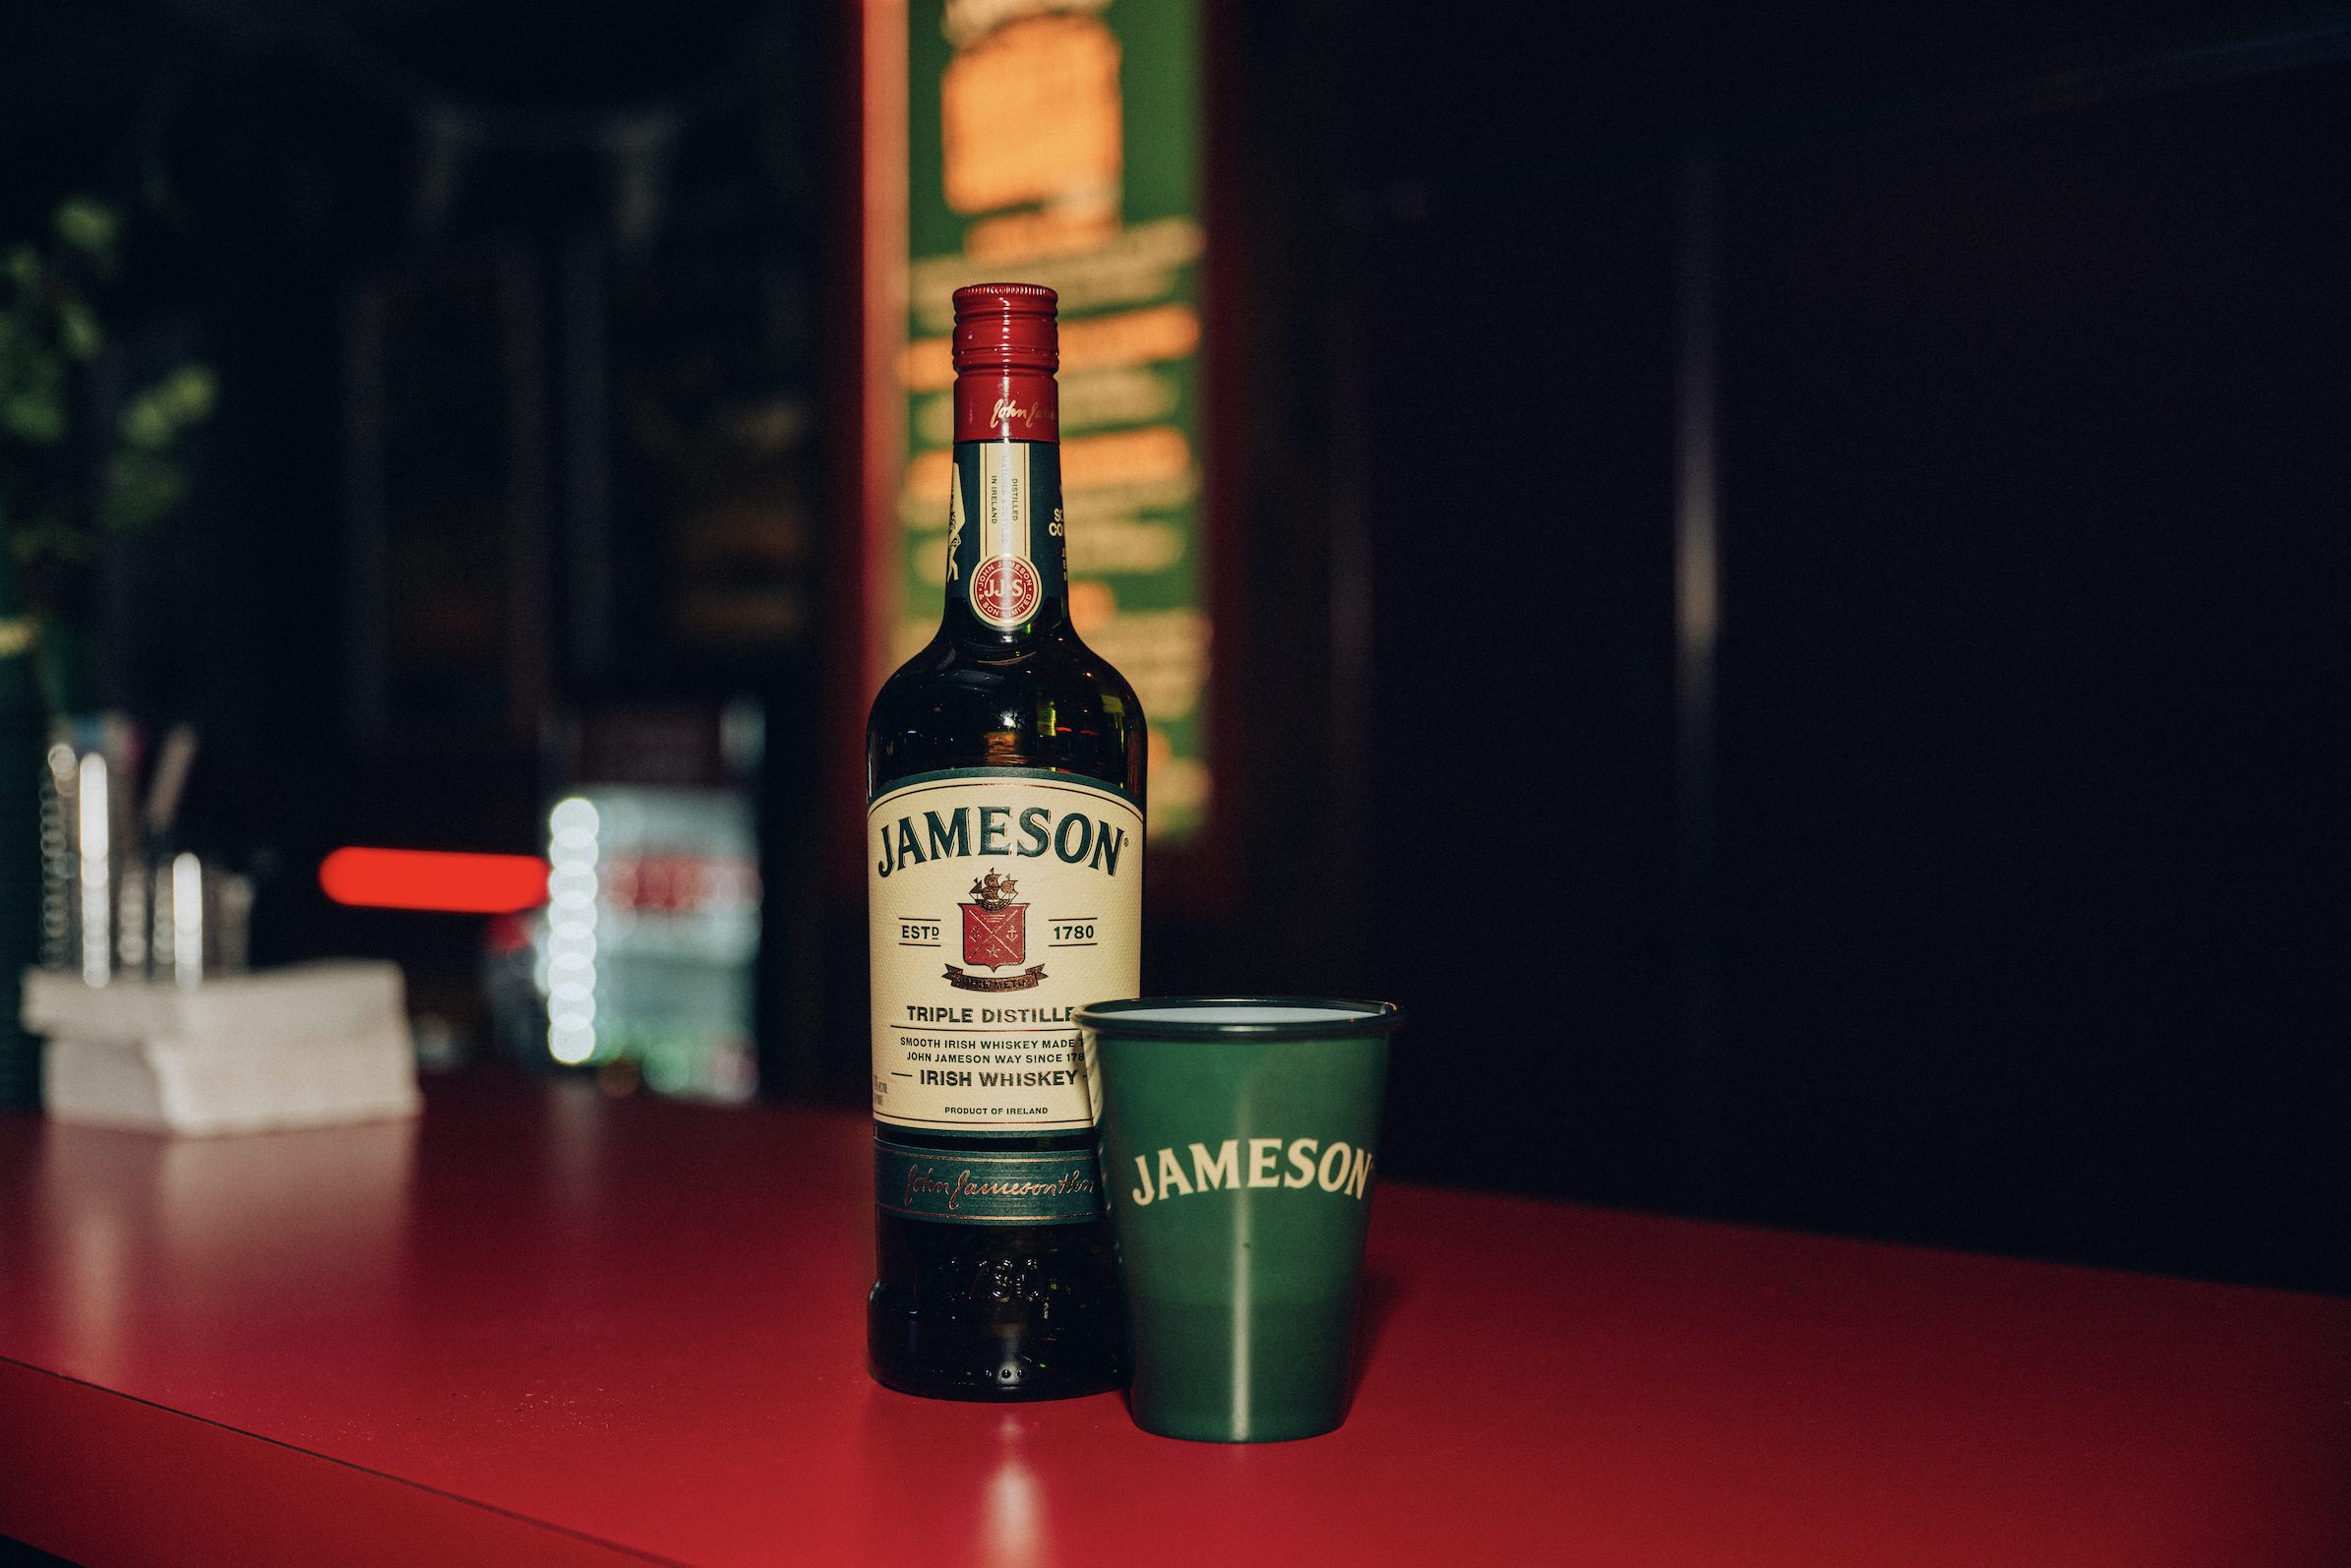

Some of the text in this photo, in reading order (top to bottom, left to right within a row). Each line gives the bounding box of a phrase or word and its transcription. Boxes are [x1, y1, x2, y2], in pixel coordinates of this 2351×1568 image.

[990, 398, 1027, 428] John
[992, 475, 997, 484] IN
[979, 565, 995, 587] JOHN
[983, 602, 1000, 617] SON
[878, 806, 1124, 877] JAMESON
[1054, 925, 1095, 940] 1780
[907, 1005, 1075, 1023] TRIPLE DISTILLE
[900, 1037, 941, 1049] SMOOTH
[944, 1040, 976, 1050] IRISH
[981, 1041, 1039, 1050] WHISKEY
[1042, 1038, 1075, 1049] MADE
[907, 1052, 1085, 1063] JOHN JAMESON WAY SINCE 178
[920, 1069, 1079, 1087] IRISH WHISKEY
[1132, 1137, 1372, 1206] JAMESON
[904, 1164, 949, 1206] John
[948, 1169, 1057, 1211] Jameson
